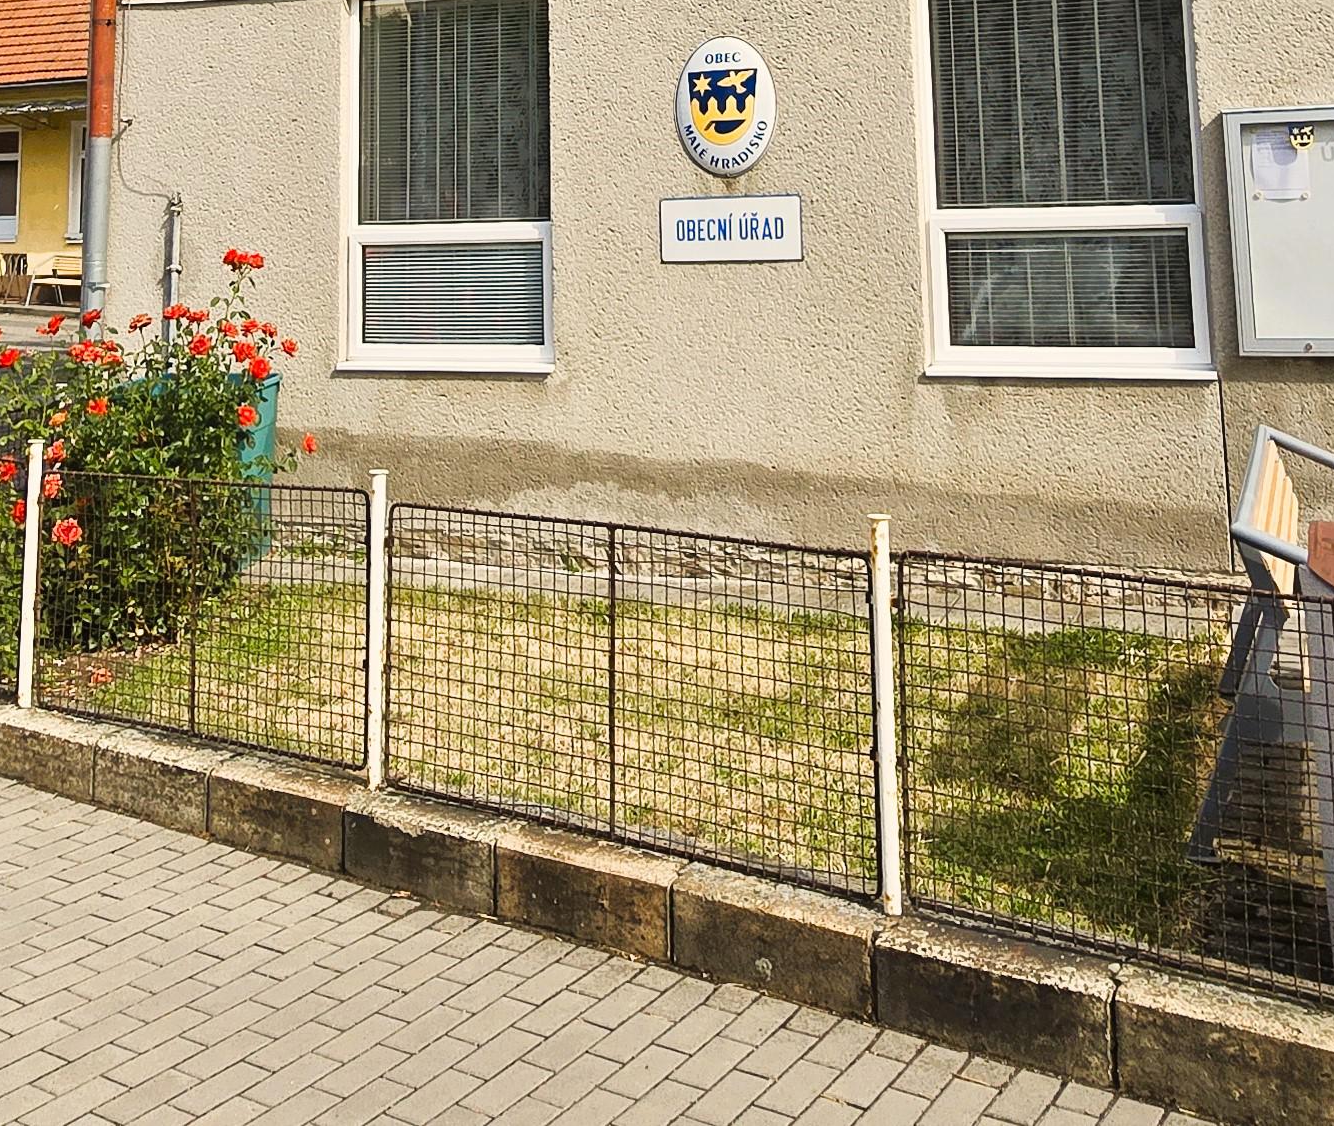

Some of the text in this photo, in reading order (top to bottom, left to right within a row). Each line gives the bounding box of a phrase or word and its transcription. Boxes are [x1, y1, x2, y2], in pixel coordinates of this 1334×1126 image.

[704, 51, 742, 65] OBEC
[683, 120, 768, 169] MALÉ HRADISKO
[676, 211, 784, 242] OBECNÍ ÚŘAD
